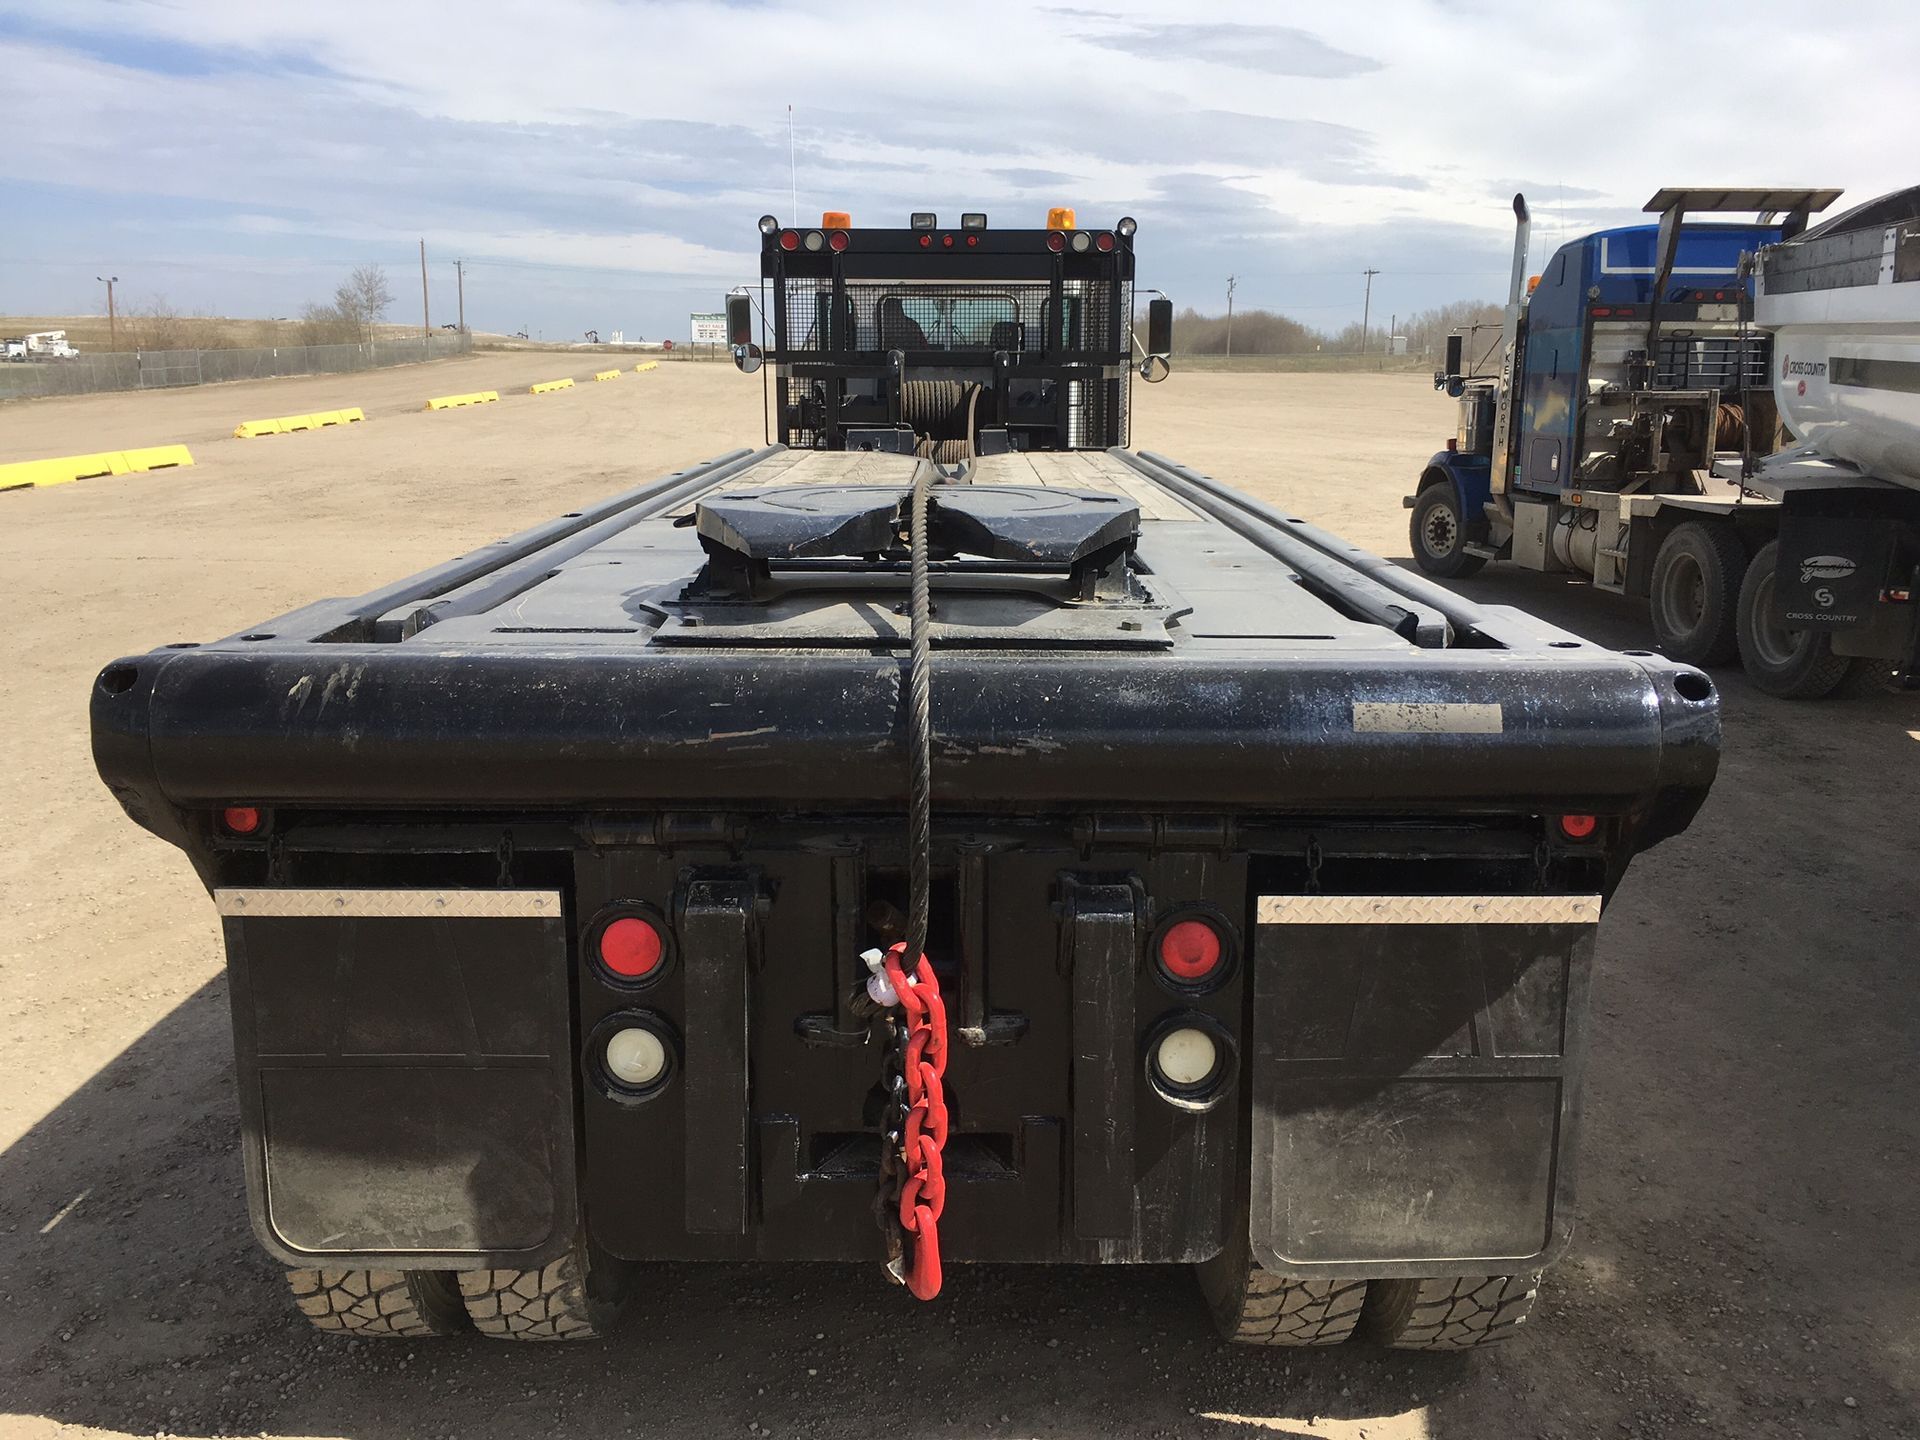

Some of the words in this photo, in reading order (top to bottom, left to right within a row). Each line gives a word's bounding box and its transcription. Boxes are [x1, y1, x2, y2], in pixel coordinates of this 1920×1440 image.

[1790, 361, 1804, 375] CROSS
[1804, 362, 1827, 376] COUNTRY
[1498, 353, 1511, 447] KENWORTH
[1786, 612, 1813, 620] CROSS
[1816, 613, 1857, 622] COUNTRY
